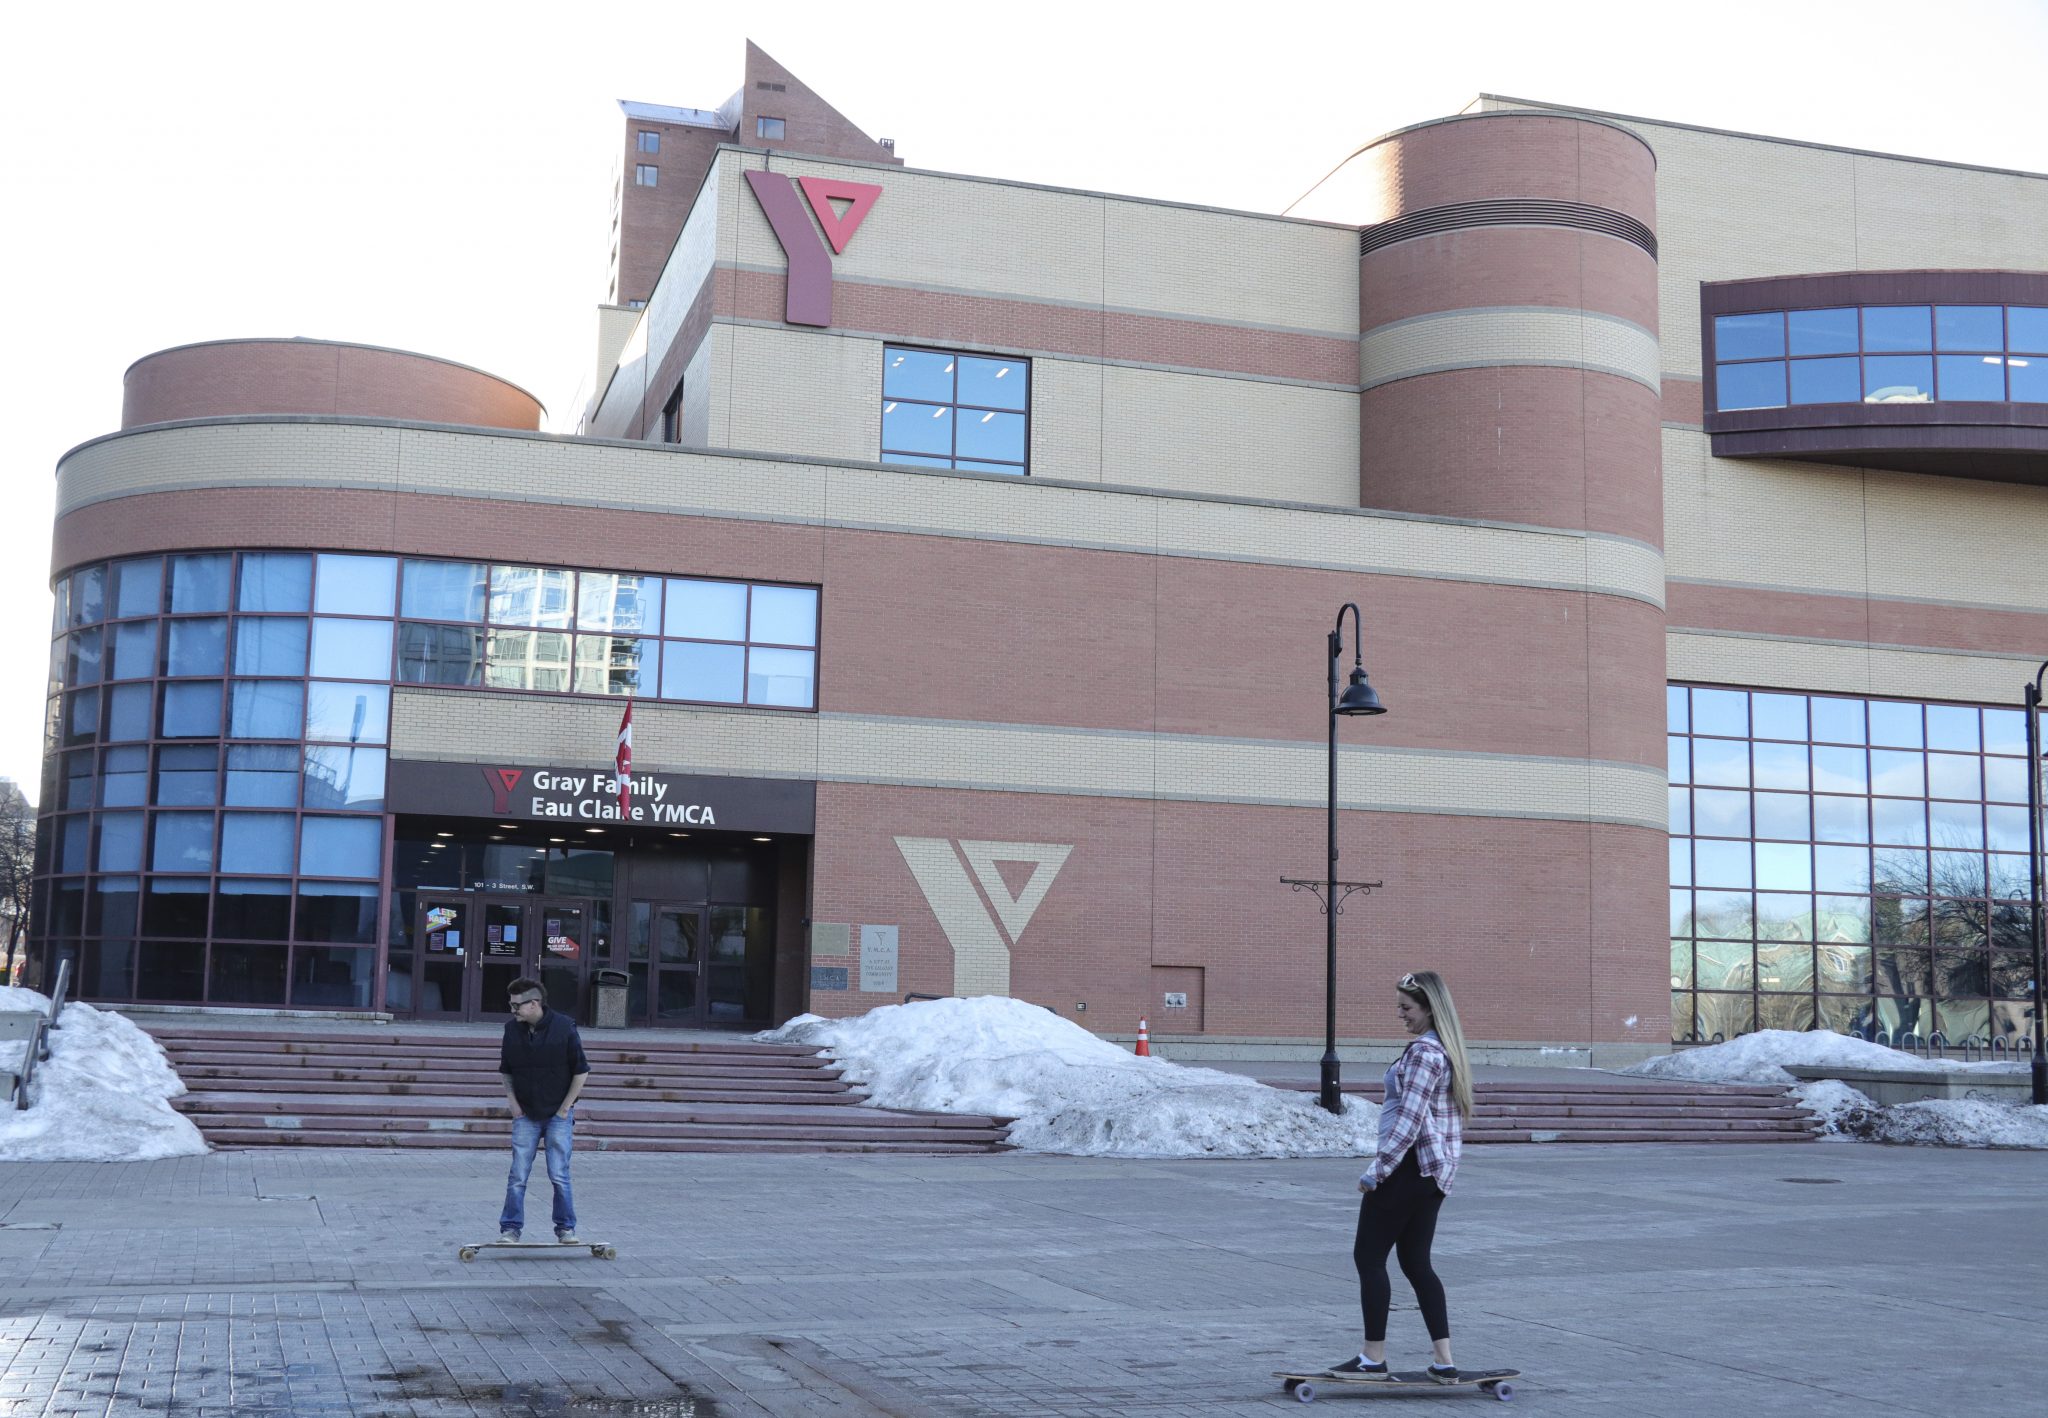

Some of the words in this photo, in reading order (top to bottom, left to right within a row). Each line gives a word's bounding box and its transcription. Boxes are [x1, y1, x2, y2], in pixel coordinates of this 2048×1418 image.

[533, 771, 587, 797] Gray
[531, 797, 573, 817] Eau
[578, 799, 644, 821] Claie
[650, 803, 716, 825] YMCA
[548, 936, 567, 944] GIVE
